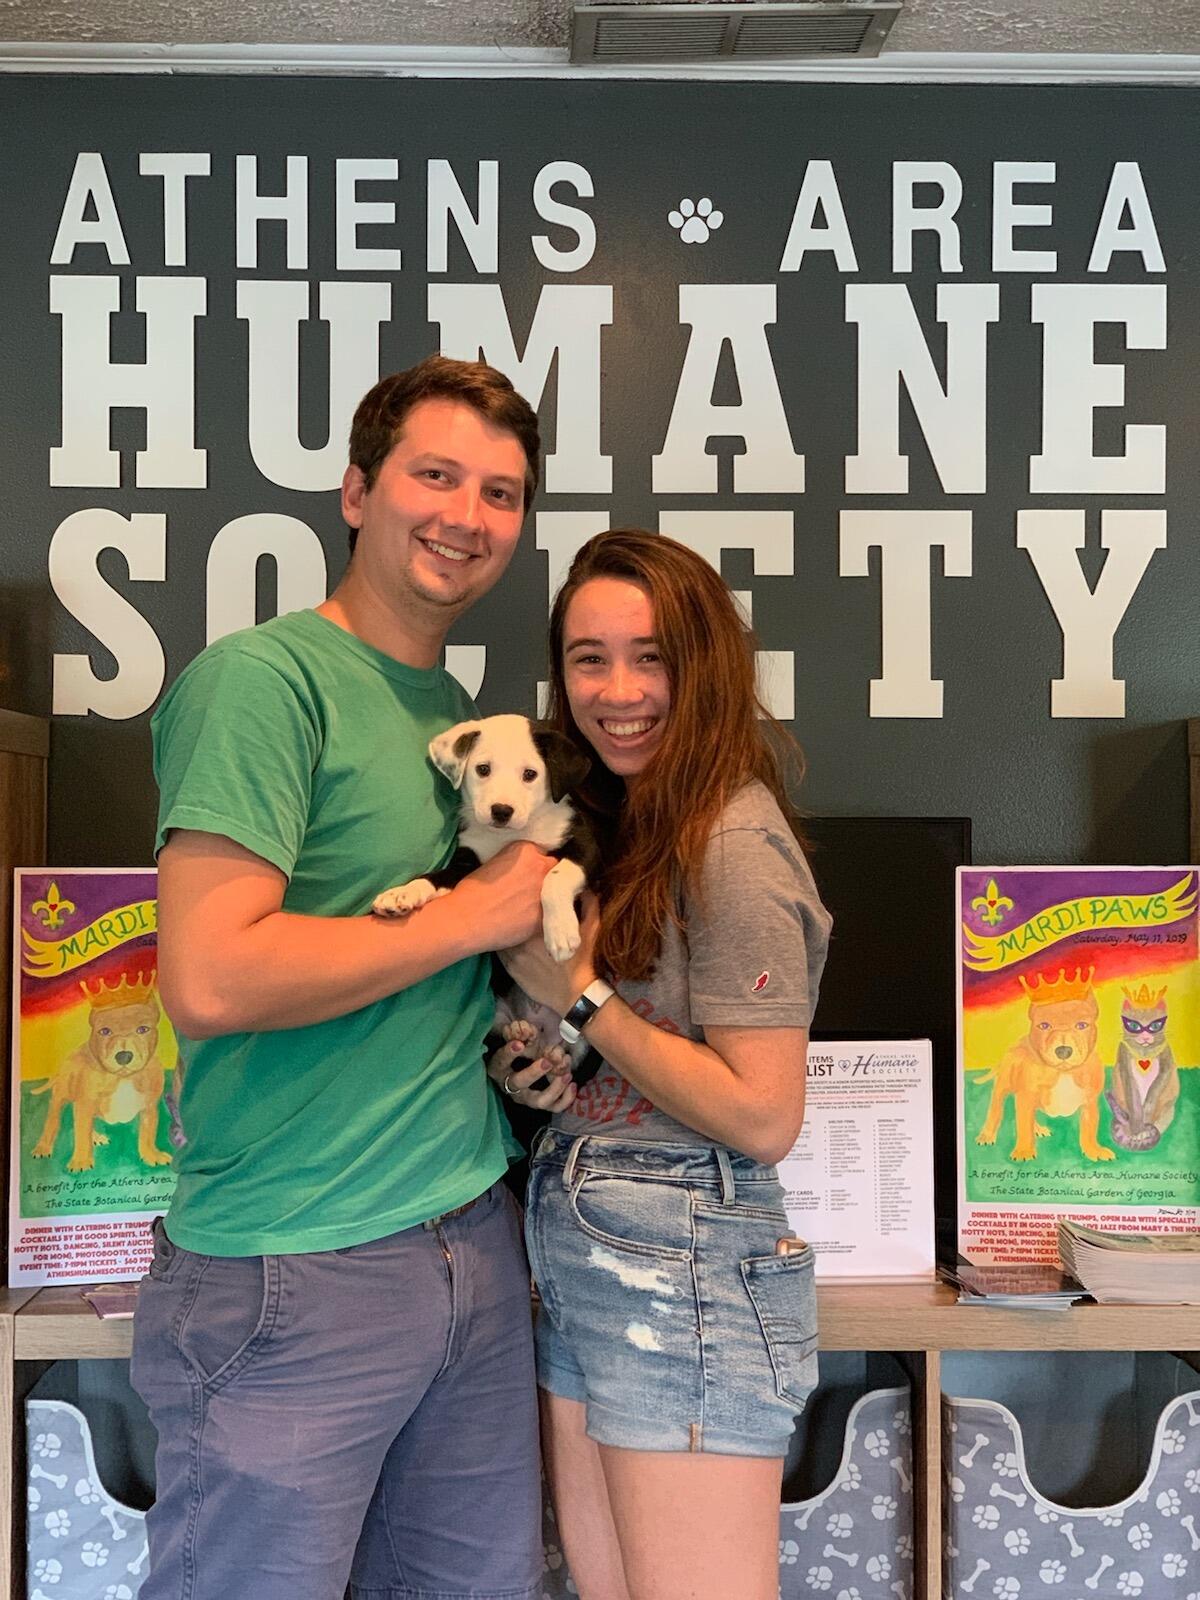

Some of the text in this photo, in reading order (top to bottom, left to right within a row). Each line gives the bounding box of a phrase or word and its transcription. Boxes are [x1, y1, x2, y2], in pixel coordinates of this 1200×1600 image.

[50, 153, 1167, 273] ATHENS AREA
[49, 275, 1167, 495] HUMANE
[48, 508, 1168, 721] SOETY
[997, 895, 1168, 962] MARDI PAWS
[57, 904, 149, 969] MARDI
[1072, 933, 1122, 947] Saturday,
[1124, 932, 1149, 947] May
[1166, 933, 1188, 944] 2019
[806, 1064, 834, 1077] LIST
[851, 1053, 919, 1077] Humane
[968, 1168, 1198, 1184] A benefit for the Athens Area Humane Society
[24, 1176, 172, 1195] A benefit for the Athens Area
[991, 1186, 1176, 1202] The State Botanical Garden of Georgia
[45, 1198, 63, 1209] The
[63, 1197, 91, 1208] State
[94, 1195, 142, 1207] Botanical
[967, 1220, 1007, 1228] COCKTAILS
[972, 1211, 998, 1219] DINNER
[1068, 1214, 1099, 1222] TRUMPS,
[1100, 1214, 1121, 1222] OPEN
[1122, 1215, 1137, 1223] BAR
[1138, 1215, 1157, 1223] WITH
[1158, 1216, 1197, 1224] SPECIALTY
[25, 1226, 53, 1235] DINNER
[54, 1225, 73, 1233] WITH
[75, 1223, 112, 1232] CATERING
[124, 1221, 151, 1229] TRUMP
[1009, 1230, 1045, 1238] DANCING,
[1100, 1223, 1117, 1231] JAZZ
[1141, 1224, 1162, 1232] MARY
[1171, 1225, 1184, 1233] THE
[20, 1235, 62, 1244] COCKTAILS
[63, 1234, 73, 1242] BY
[75, 1233, 83, 1241] IN
[84, 1232, 108, 1240] GOOD
[110, 1231, 138, 1239] SPIRITS,
[1021, 1239, 1058, 1247] PHOTOBO
[14, 1245, 39, 1254] HOTTY
[63, 1242, 101, 1250] DANCING,
[103, 1240, 126, 1248] SILENT
[127, 1238, 155, 1247] AUCTIO
[33, 1254, 48, 1262] FOR
[76, 1249, 131, 1259] PHOTOBOOTH,
[993, 1255, 1061, 1264] ATHENSHUMANESO
[19, 1263, 42, 1271] EVENT
[89, 1259, 117, 1267] TICKETS
[124, 1257, 138, 1265] $60
[47, 1266, 151, 1279] ATHENSHUMANESOCIETY.OR
